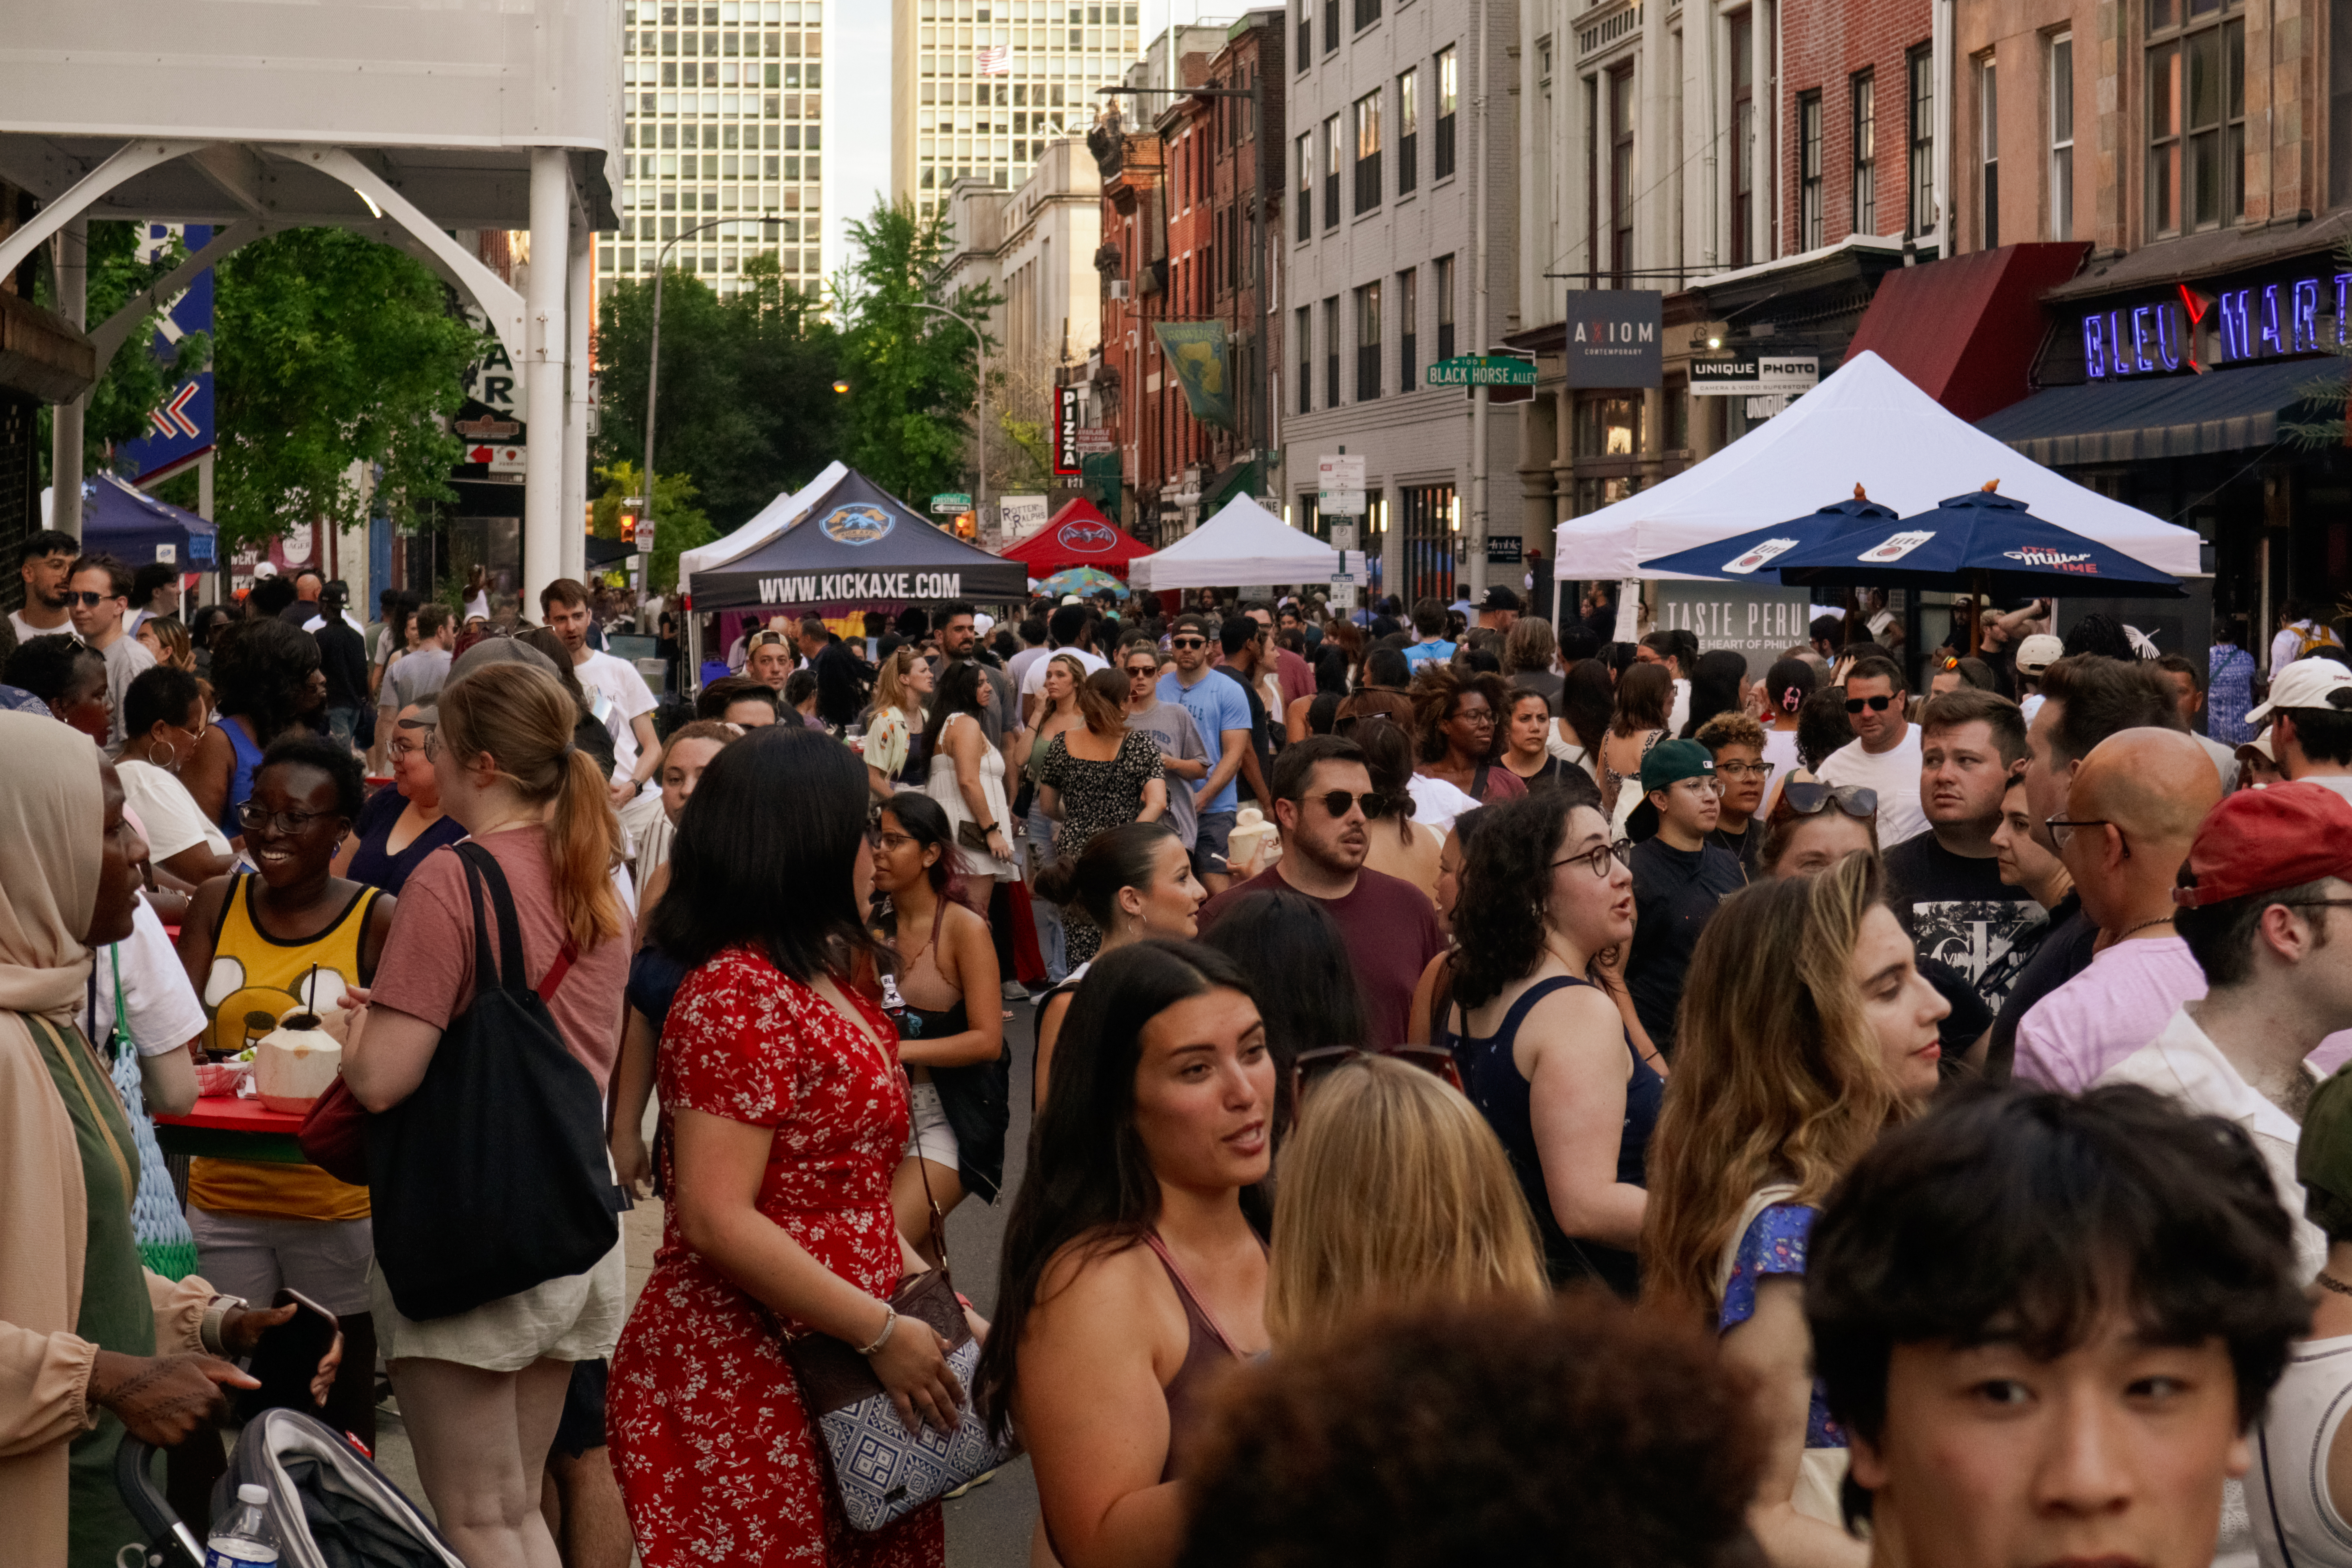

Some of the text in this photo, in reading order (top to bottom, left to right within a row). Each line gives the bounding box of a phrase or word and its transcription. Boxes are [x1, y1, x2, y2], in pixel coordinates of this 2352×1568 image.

[1575, 322, 1653, 342] AXIOM
[2086, 305, 2179, 377] BLEU
[1430, 367, 1537, 383] BLACK HORSE ALLEY
[1695, 363, 1815, 375] UNIQUE PHOTO
[1063, 391, 1076, 465] PIZZA
[1002, 504, 1037, 521] ROTTEN
[1012, 512, 1046, 528] RALPHS
[1752, 545, 1786, 554] Lite
[1886, 538, 1924, 547] Lite
[2022, 546, 2058, 555] IT'S
[2003, 552, 2091, 565] Miller
[2053, 563, 2098, 574] TIME
[759, 573, 960, 603] WWW.KICKAXE.COM
[1667, 602, 1732, 636] TASTE
[1748, 603, 1801, 636] PERU
[1708, 640, 1745, 649] HEART
[1747, 640, 1762, 649] OF
[1152, 730, 1171, 744] PREP
